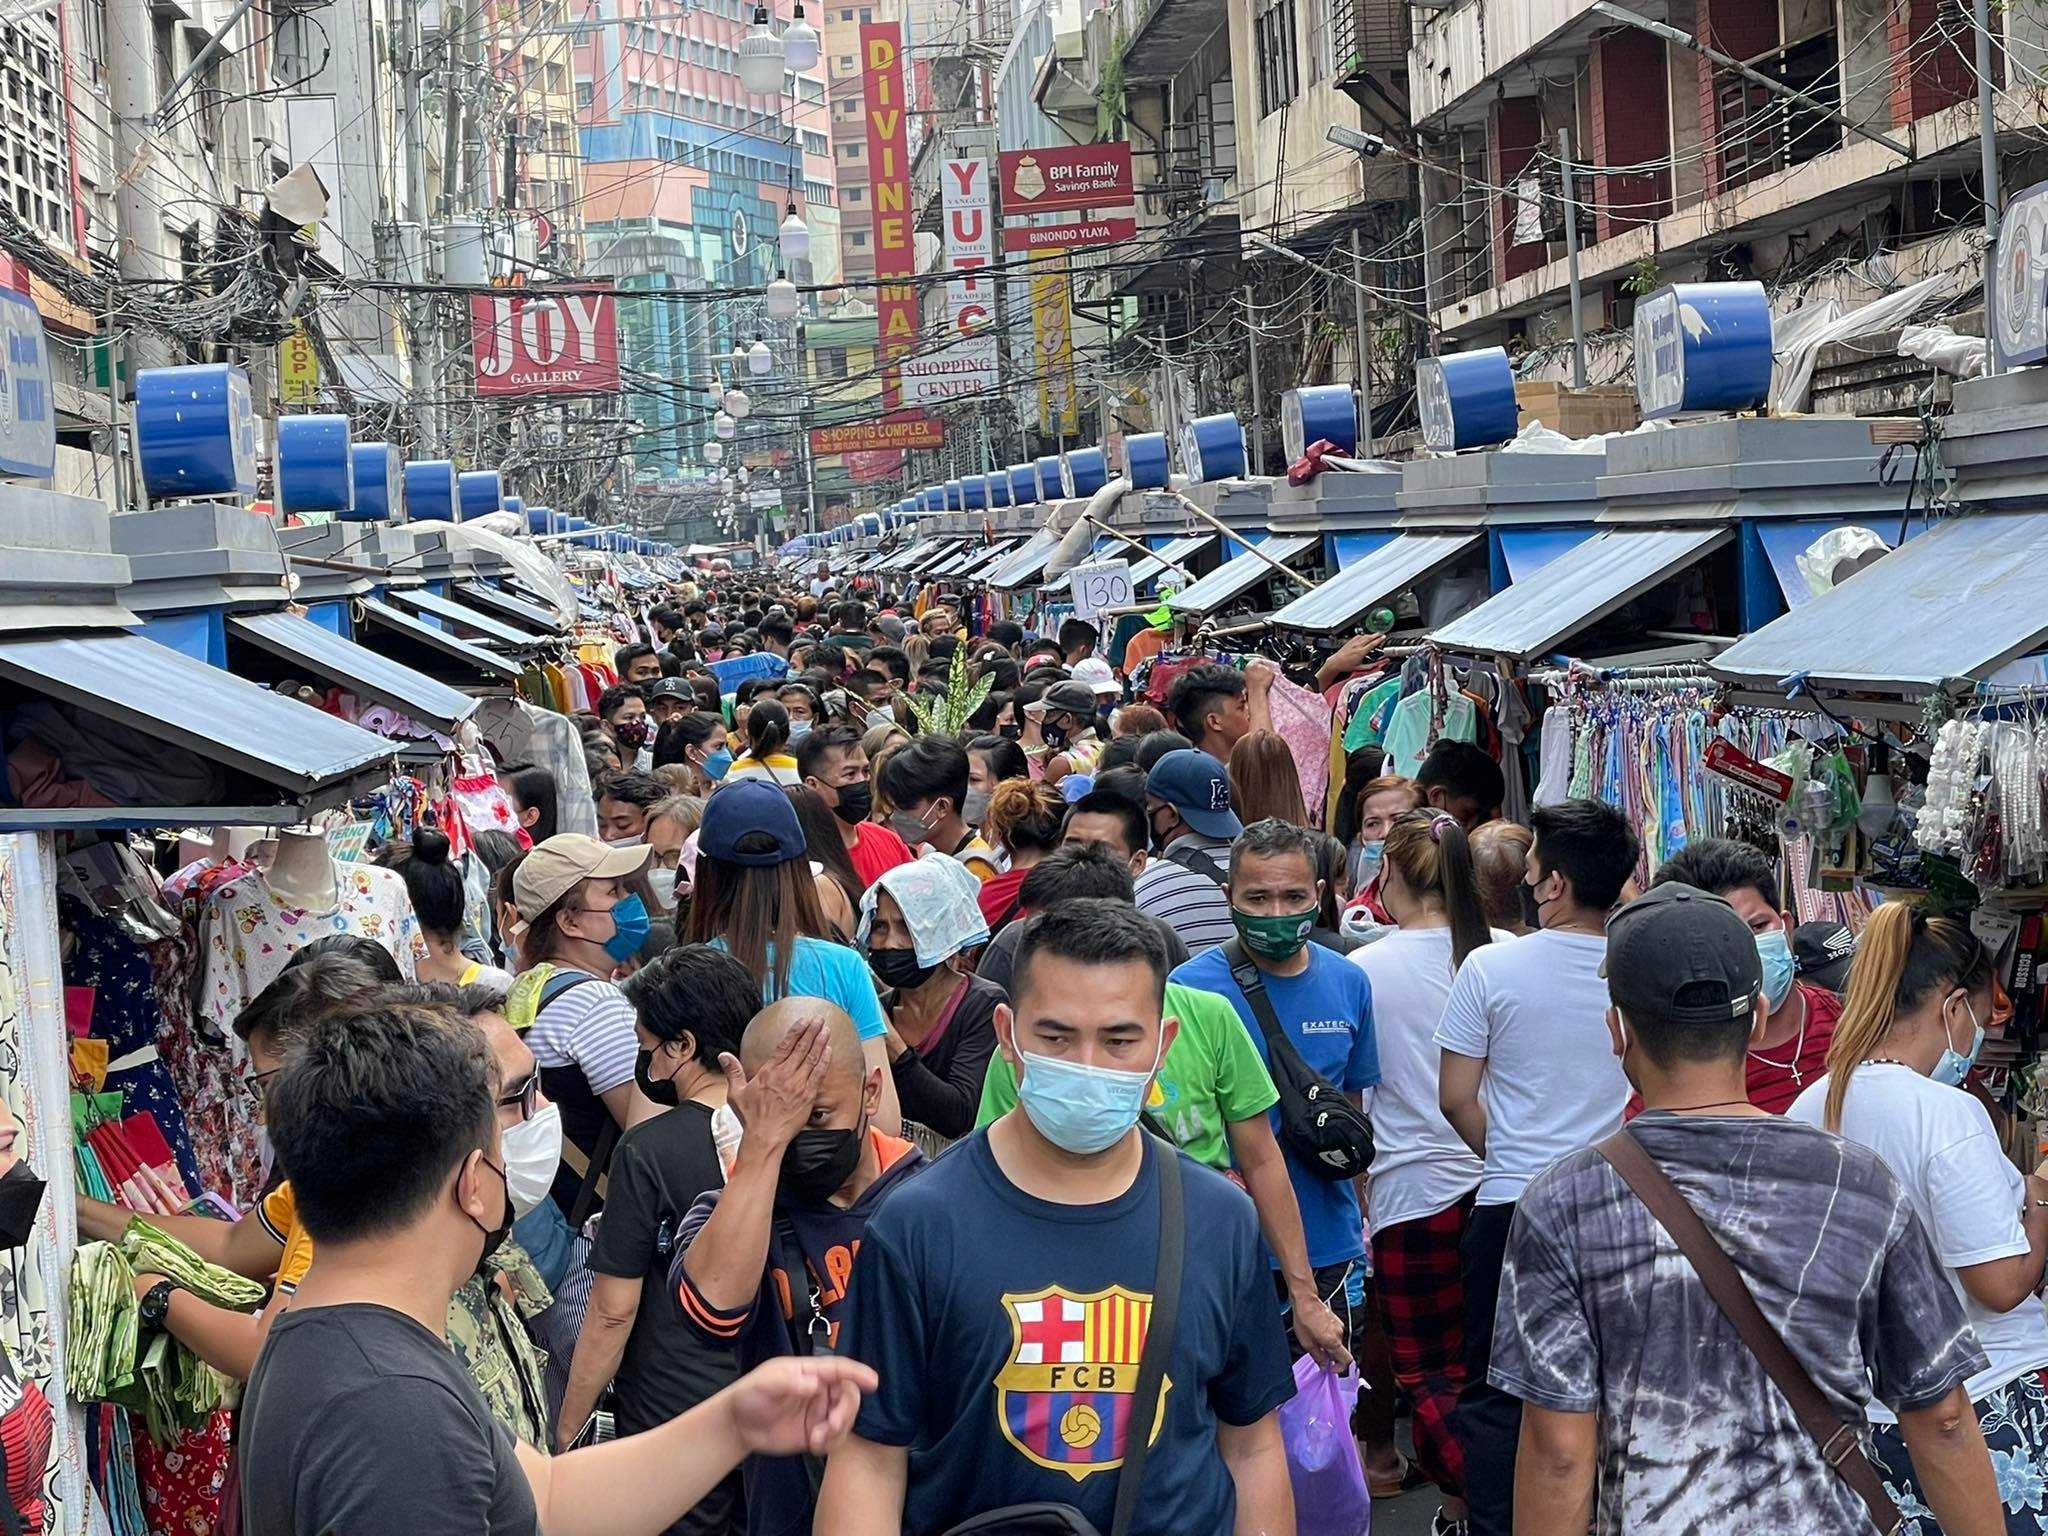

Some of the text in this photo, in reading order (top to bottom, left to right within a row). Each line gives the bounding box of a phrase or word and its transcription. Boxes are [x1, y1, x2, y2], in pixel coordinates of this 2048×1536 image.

[868, 39, 905, 249] DIVINE
[1049, 161, 1119, 180] BPI Family
[1055, 178, 1117, 193] Savings Bank
[1029, 227, 1110, 243] BINONDO YLAYA
[952, 244, 986, 253] UNITED
[951, 291, 992, 300] TRADERS
[479, 294, 604, 377] JOY
[907, 358, 991, 376] SHOPPING
[510, 370, 584, 384] GALLERY
[917, 378, 982, 397] CENTER
[821, 421, 930, 442] SHOPPING COMPLEX
[1083, 576, 1128, 610] 130
[1302, 1020, 1351, 1030] EXATECH
[1050, 1366, 1116, 1389] FCB
